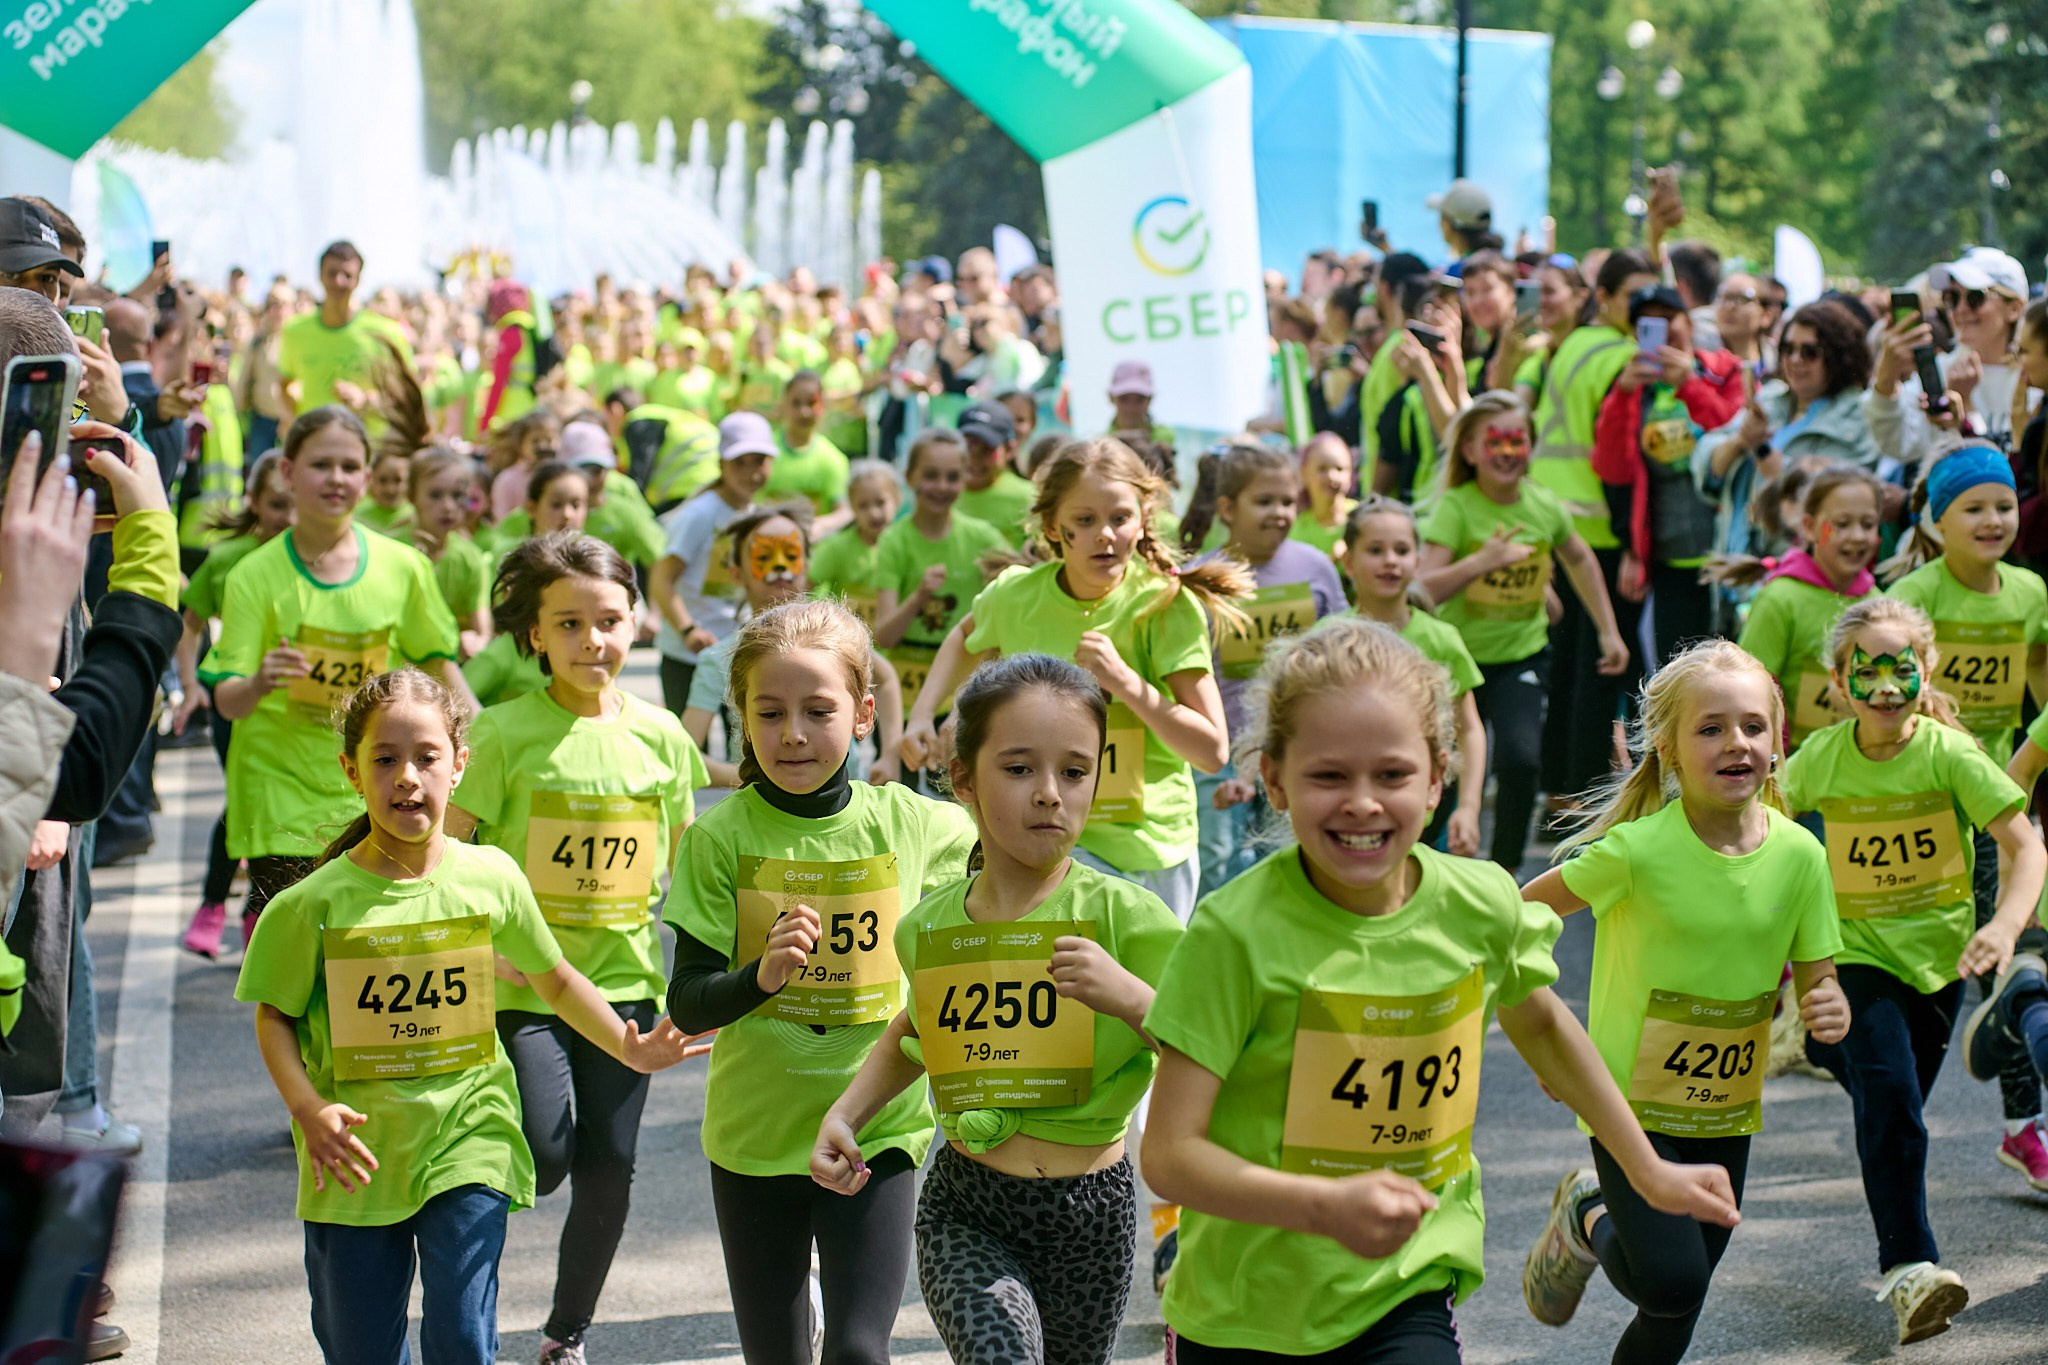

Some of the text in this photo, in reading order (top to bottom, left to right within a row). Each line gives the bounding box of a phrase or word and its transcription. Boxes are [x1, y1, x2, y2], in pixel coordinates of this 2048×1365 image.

[1101, 289, 1250, 345] СБЕР
[1943, 655, 2010, 685] 4221
[552, 835, 638, 870] 4179
[1848, 828, 1937, 868] 4215
[576, 878, 599, 892] 7-9
[798, 873, 824, 881] СБЕР
[1873, 874, 1898, 887] 7-9
[766, 910, 879, 956] 53
[963, 936, 987, 947] СБЕР
[798, 965, 853, 983] 7-9 лет
[357, 966, 467, 1014] 4245
[938, 980, 1057, 1033] 4250
[389, 1022, 442, 1039] 7-9 лет
[963, 1042, 1020, 1063] 7-9 лет
[1664, 1039, 1756, 1080] 4203
[1023, 1078, 1067, 1086] REDMOND
[1331, 1045, 1461, 1111] 4193
[993, 1091, 1041, 1100] СИТИДРАЙВ
[1686, 1086, 1730, 1103] 7-9 лет
[1370, 1124, 1433, 1145] 7-9 лет
